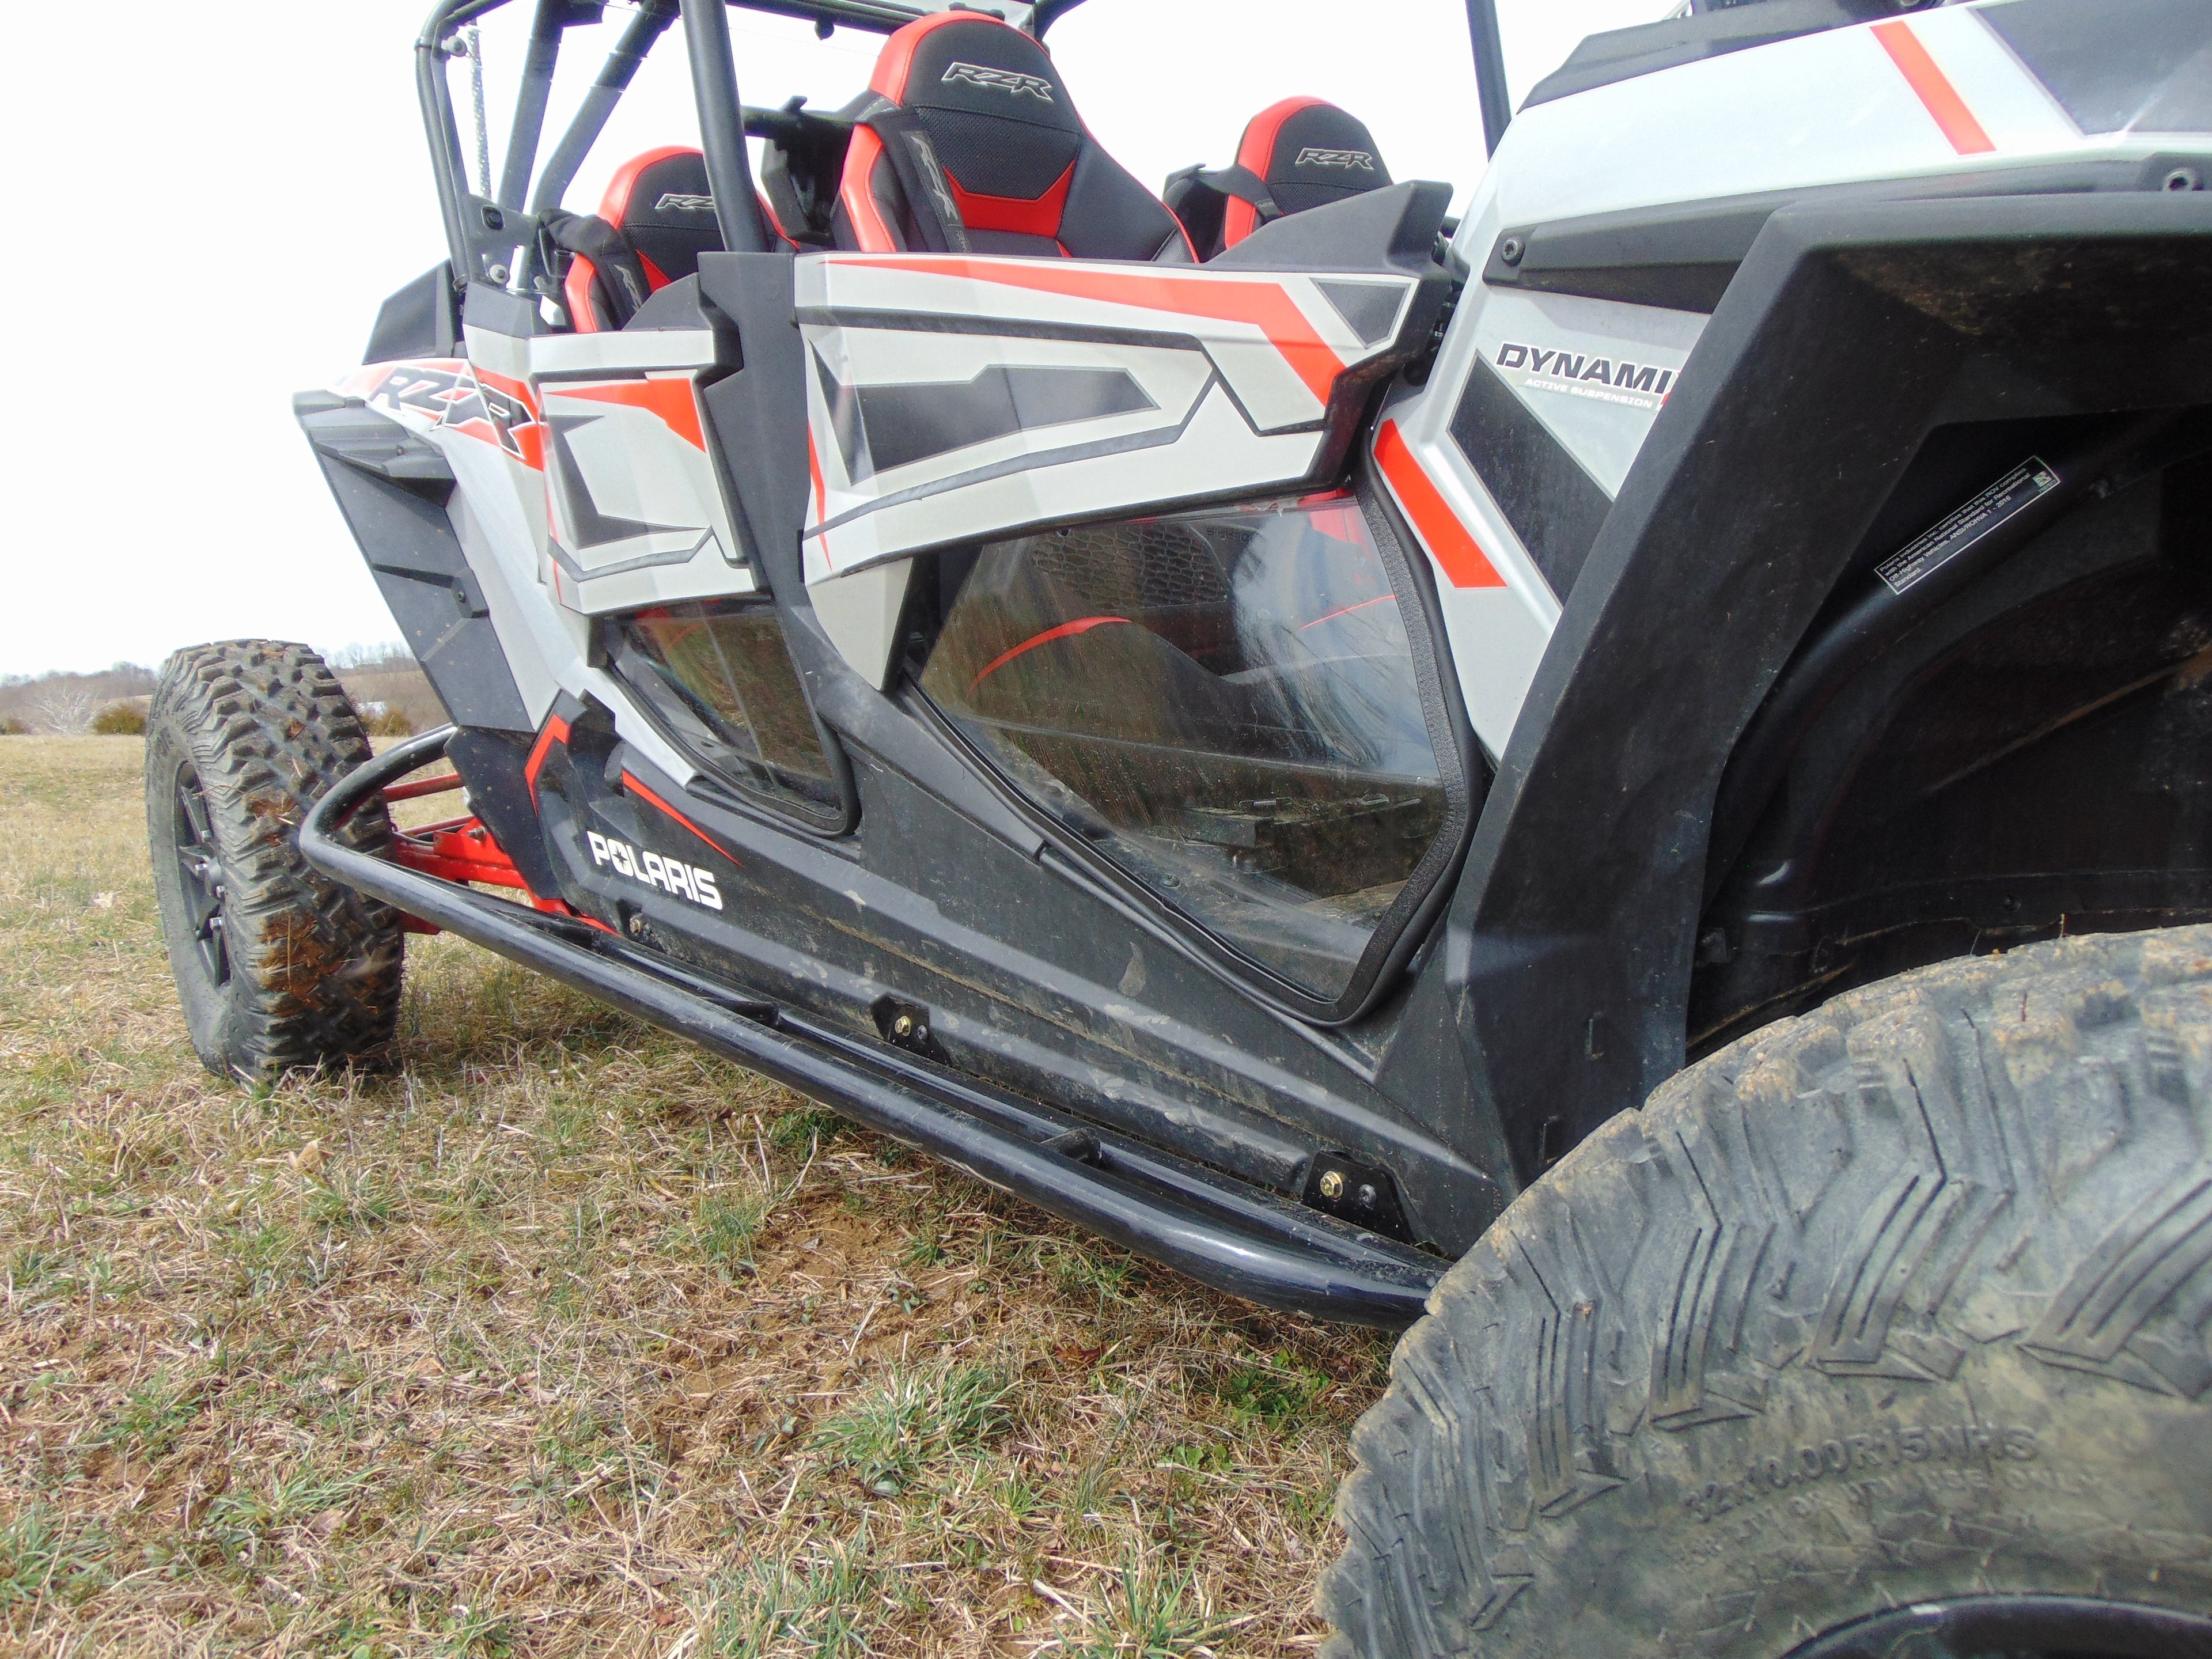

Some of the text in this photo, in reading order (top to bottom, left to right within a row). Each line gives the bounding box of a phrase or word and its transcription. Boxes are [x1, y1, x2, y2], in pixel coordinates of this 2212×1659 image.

[941, 62, 1054, 103] RZR
[1295, 147, 1374, 171] RZR
[654, 194, 716, 211] RZ
[613, 264, 642, 312] RZ
[1496, 342, 1680, 402] DYNAMI
[1524, 378, 1653, 408] ACTIVE SUSPENSION
[368, 366, 537, 461] RZR
[1879, 467, 2027, 572] Polaris Industries Inc. certifies that this ROV complies
[1884, 472, 2031, 577] with the American National Standard for Recreational
[1888, 555, 1925, 582] Off-Highway
[1923, 537, 1950, 558] Vehicles,
[1948, 511, 1988, 540] ANSI/ROHVA
[1994, 494, 2012, 507] 2016
[1893, 566, 1922, 588] Standard.
[586, 831, 723, 910] POLARIS
